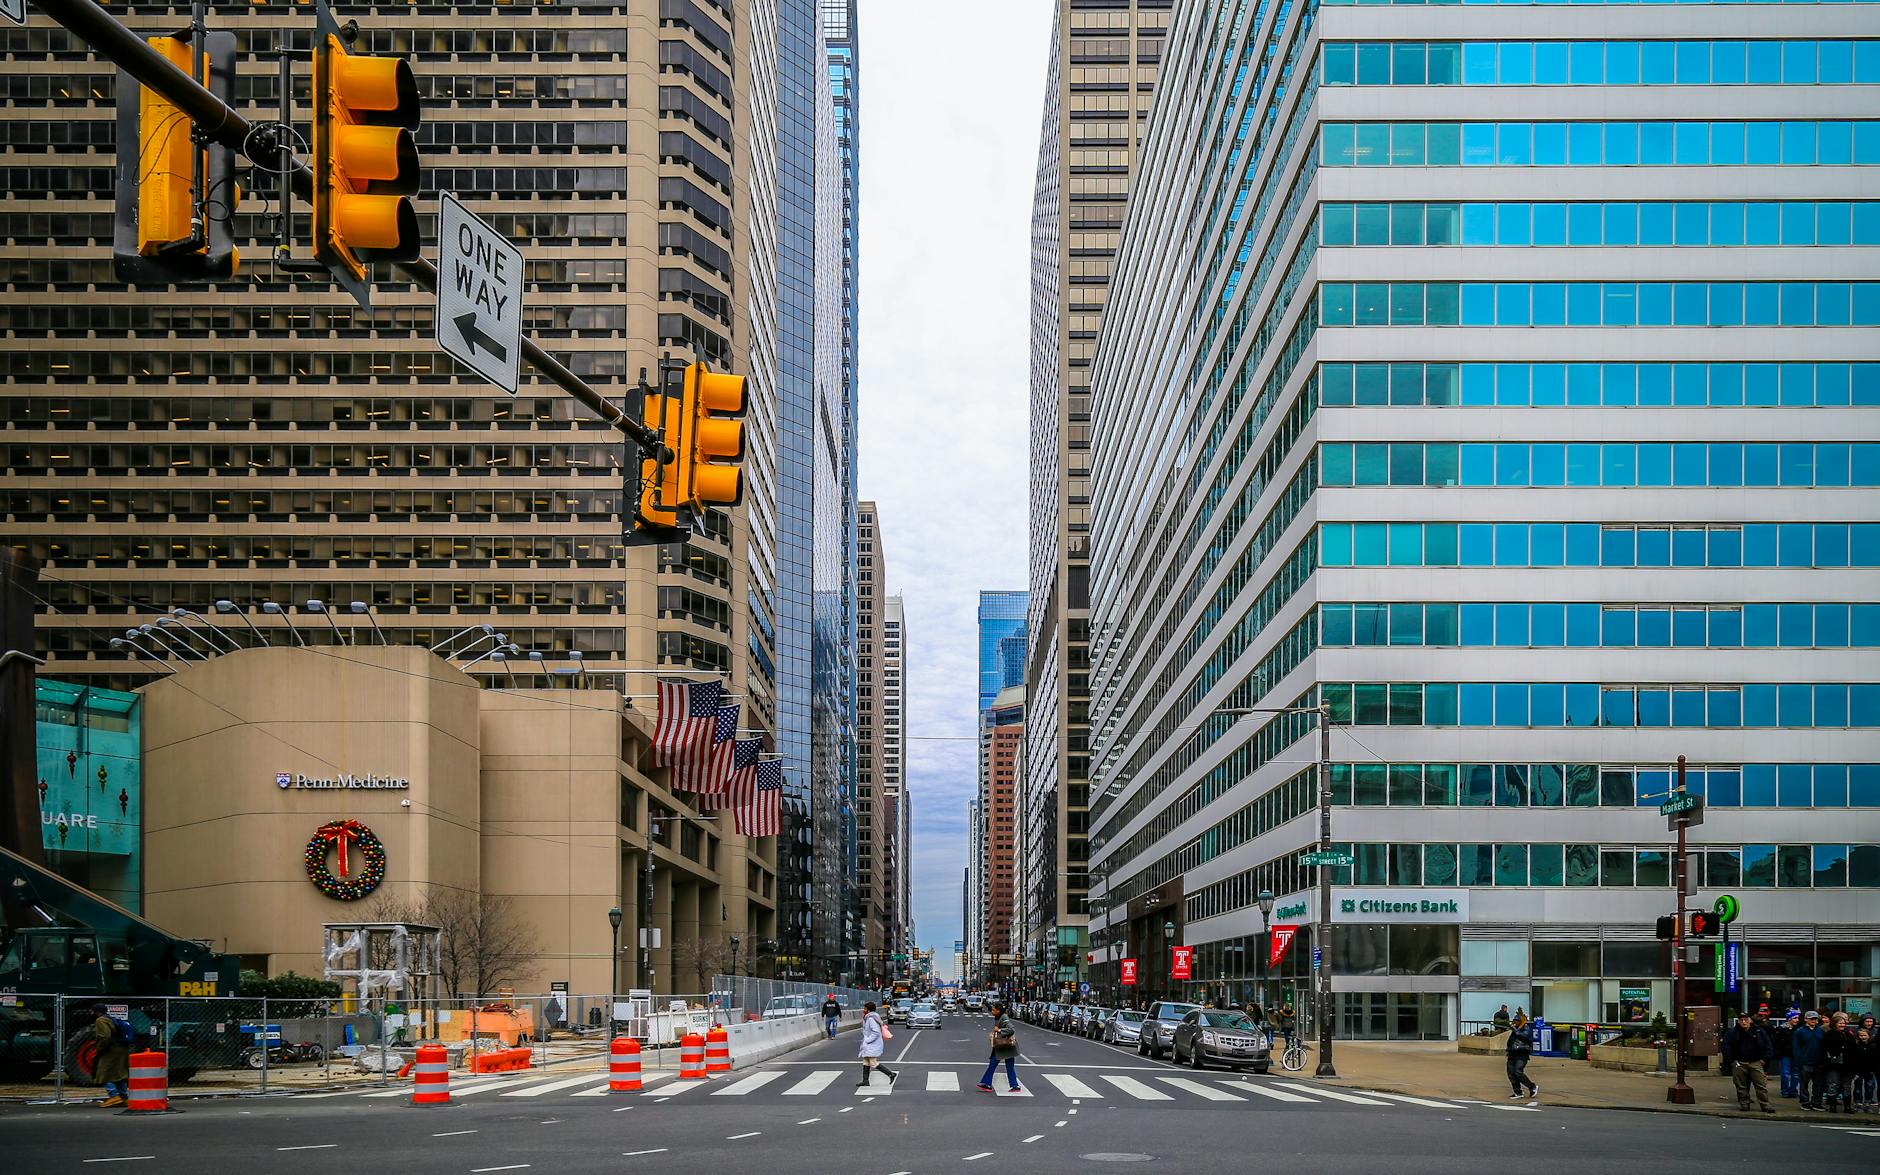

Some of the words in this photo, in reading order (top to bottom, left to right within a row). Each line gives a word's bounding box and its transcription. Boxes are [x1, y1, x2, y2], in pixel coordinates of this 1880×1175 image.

[458, 222, 508, 287] ONE
[455, 258, 508, 322] WAY
[295, 774, 333, 789] Penn
[337, 772, 409, 789] Medicine
[1662, 799, 1684, 815] Market
[1686, 797, 1694, 808] St
[1359, 899, 1418, 913] Citizens
[1420, 898, 1458, 913] Bank
[179, 981, 216, 997] P&H
